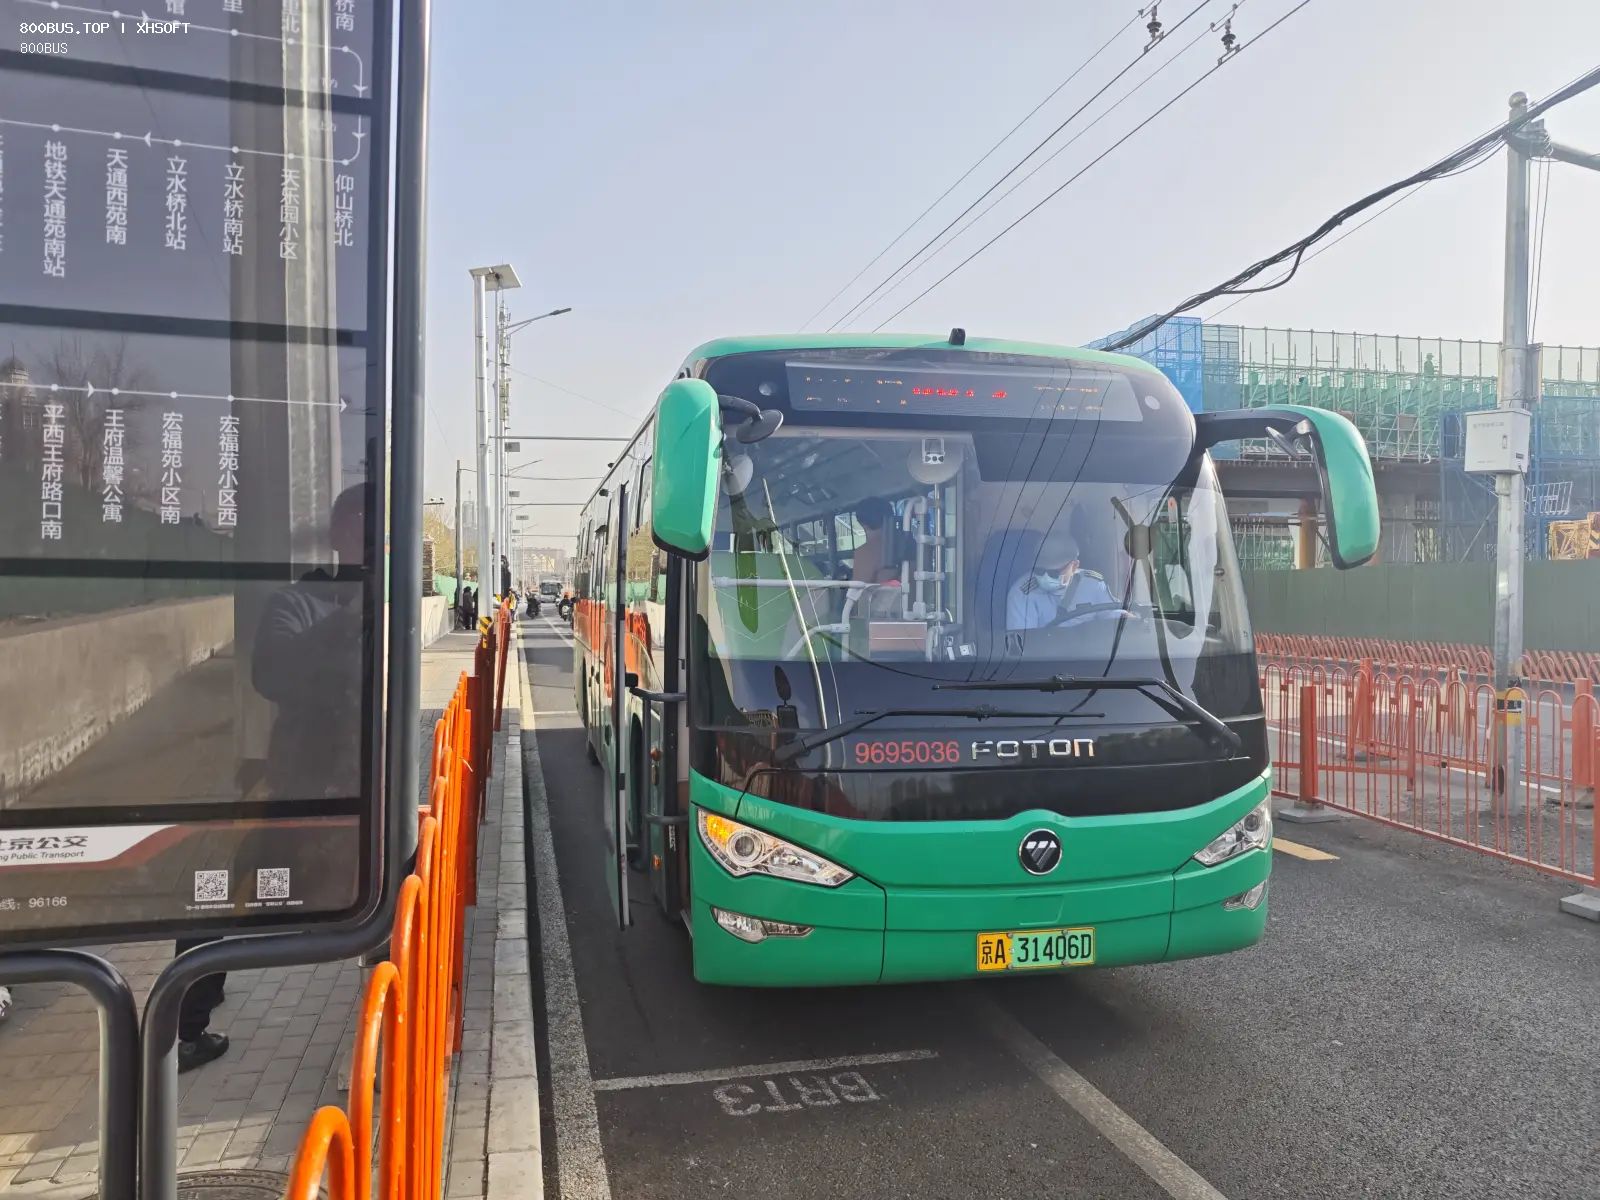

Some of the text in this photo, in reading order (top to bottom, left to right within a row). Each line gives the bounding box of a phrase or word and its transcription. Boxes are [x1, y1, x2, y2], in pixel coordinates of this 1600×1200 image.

[44, 140, 67, 278] 地铁天通苑南站
[106, 148, 128, 245] 天通西苑南
[165, 155, 187, 250] 立水桥北站
[222, 161, 244, 255] 立水桥南站
[279, 168, 300, 260] 天乐园小区
[333, 173, 354, 247] 仰山桥北
[41, 404, 65, 540] 平西王府路口南
[102, 409, 125, 522] 王府温馨公寓
[160, 412, 183, 525] 宏福苑小区南
[218, 415, 240, 526] 宏福苑小区西
[855, 741, 960, 764] 9695036
[11, 852, 38, 860] Public
[40, 850, 84, 859] Transport
[28, 896, 67, 909] 96166
[1016, 933, 1092, 963] 31406D
[713, 1071, 881, 1117] BRT3
